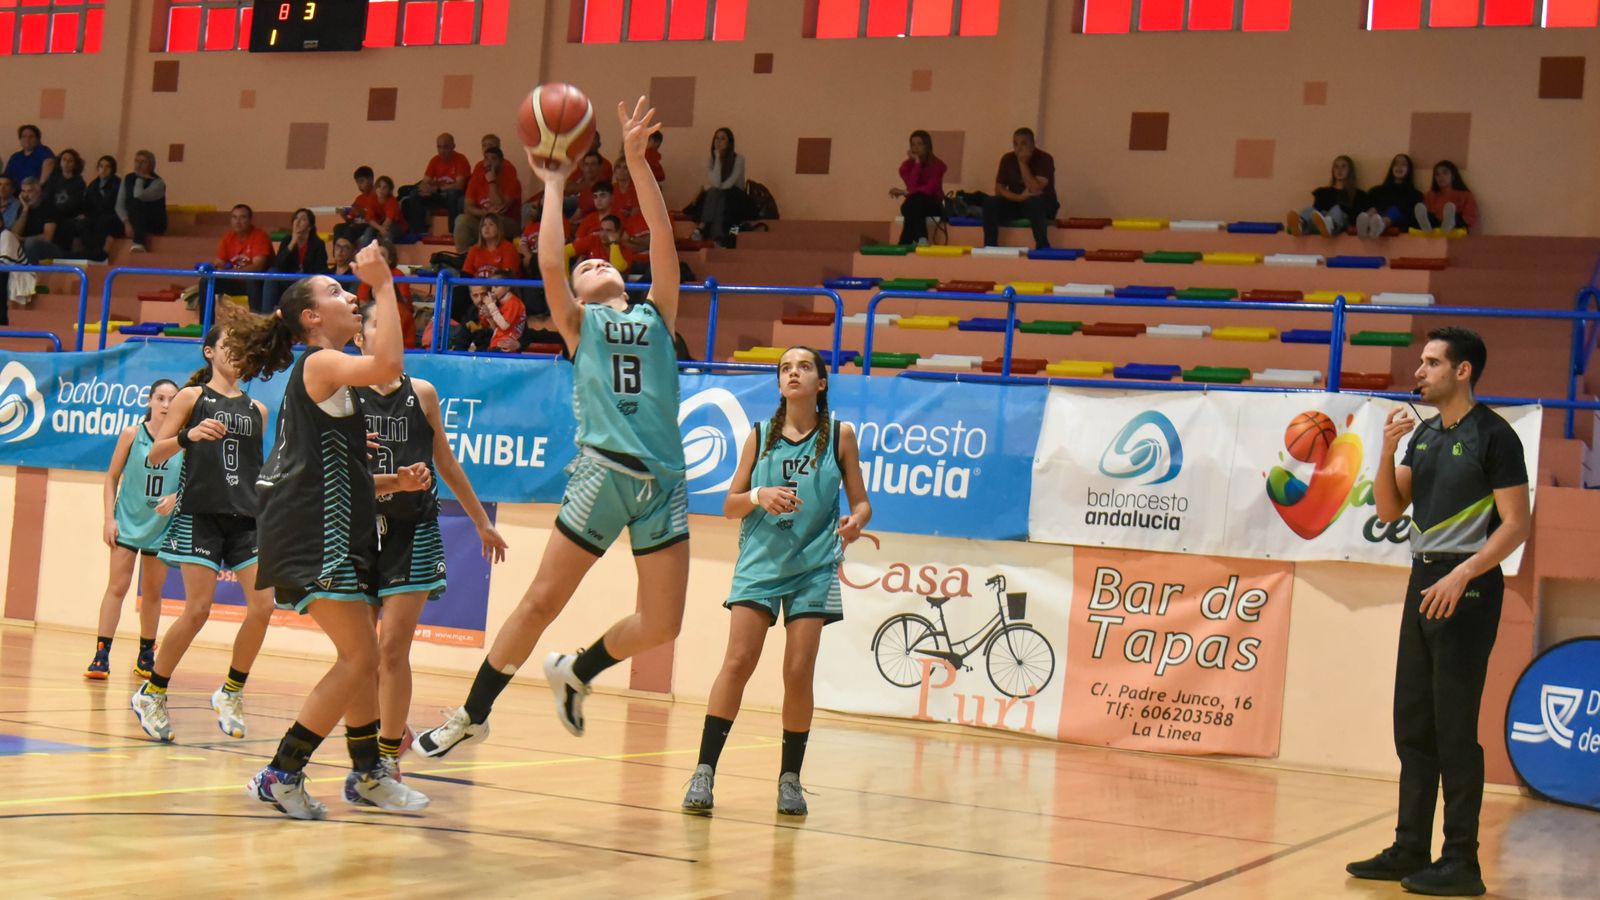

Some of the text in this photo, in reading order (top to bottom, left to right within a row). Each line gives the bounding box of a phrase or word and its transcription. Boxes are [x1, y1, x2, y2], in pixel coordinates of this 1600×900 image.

[279, 2, 316, 20] 8 3
[269, 29, 277, 46] 1
[604, 320, 650, 347] CDZ
[611, 353, 642, 395] 13
[831, 410, 988, 459] ncesto
[223, 438, 239, 472] 8
[145, 473, 164, 497] 10
[858, 455, 971, 499] alucía
[1086, 486, 1189, 513] baloncesto
[837, 532, 973, 598] Casa
[1087, 566, 1269, 622] Bar de
[1087, 613, 1262, 677] Tapas
[912, 657, 1038, 735] Puri
[1090, 682, 1253, 711] C/. Padre Junco, 16
[1105, 701, 1234, 727] Tlf: 606203588
[1132, 721, 1202, 742] La Linea
